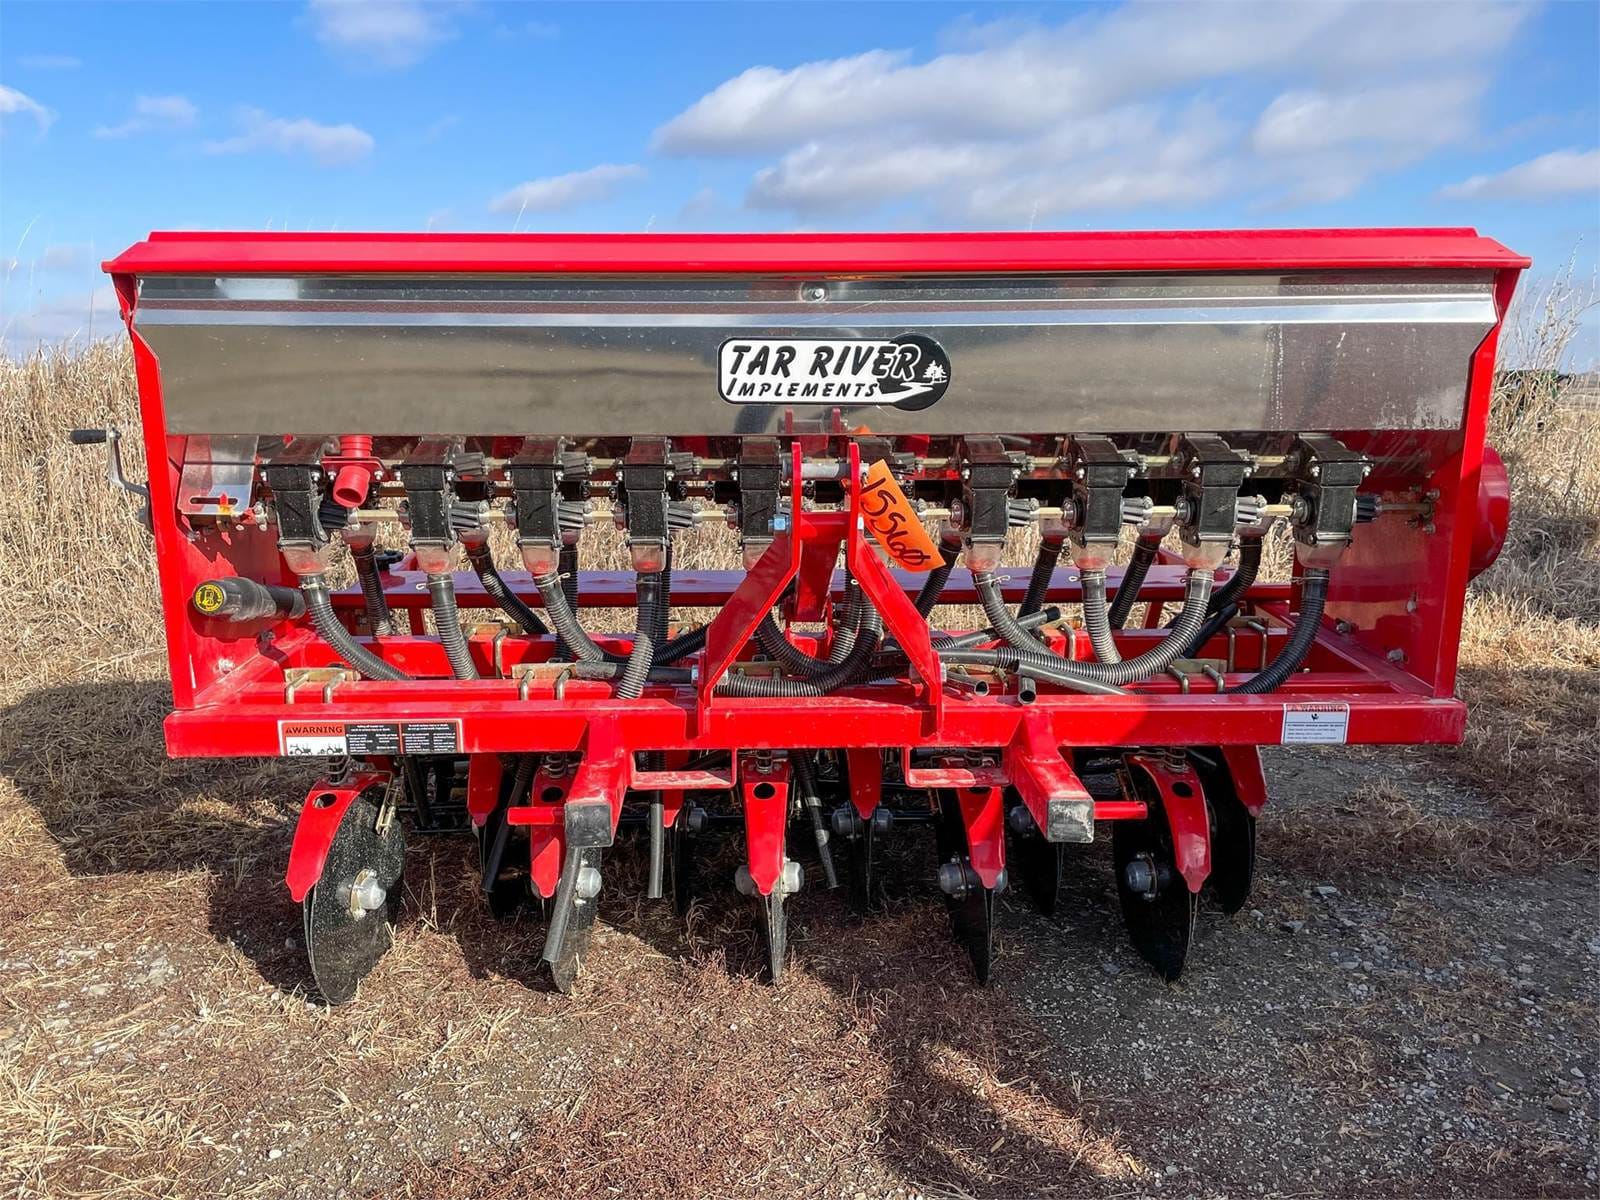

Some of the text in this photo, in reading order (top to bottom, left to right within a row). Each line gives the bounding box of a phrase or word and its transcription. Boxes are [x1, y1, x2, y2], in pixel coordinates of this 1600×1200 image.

[730, 345, 919, 380] TAR RIVER
[292, 725, 343, 734] WARNING
